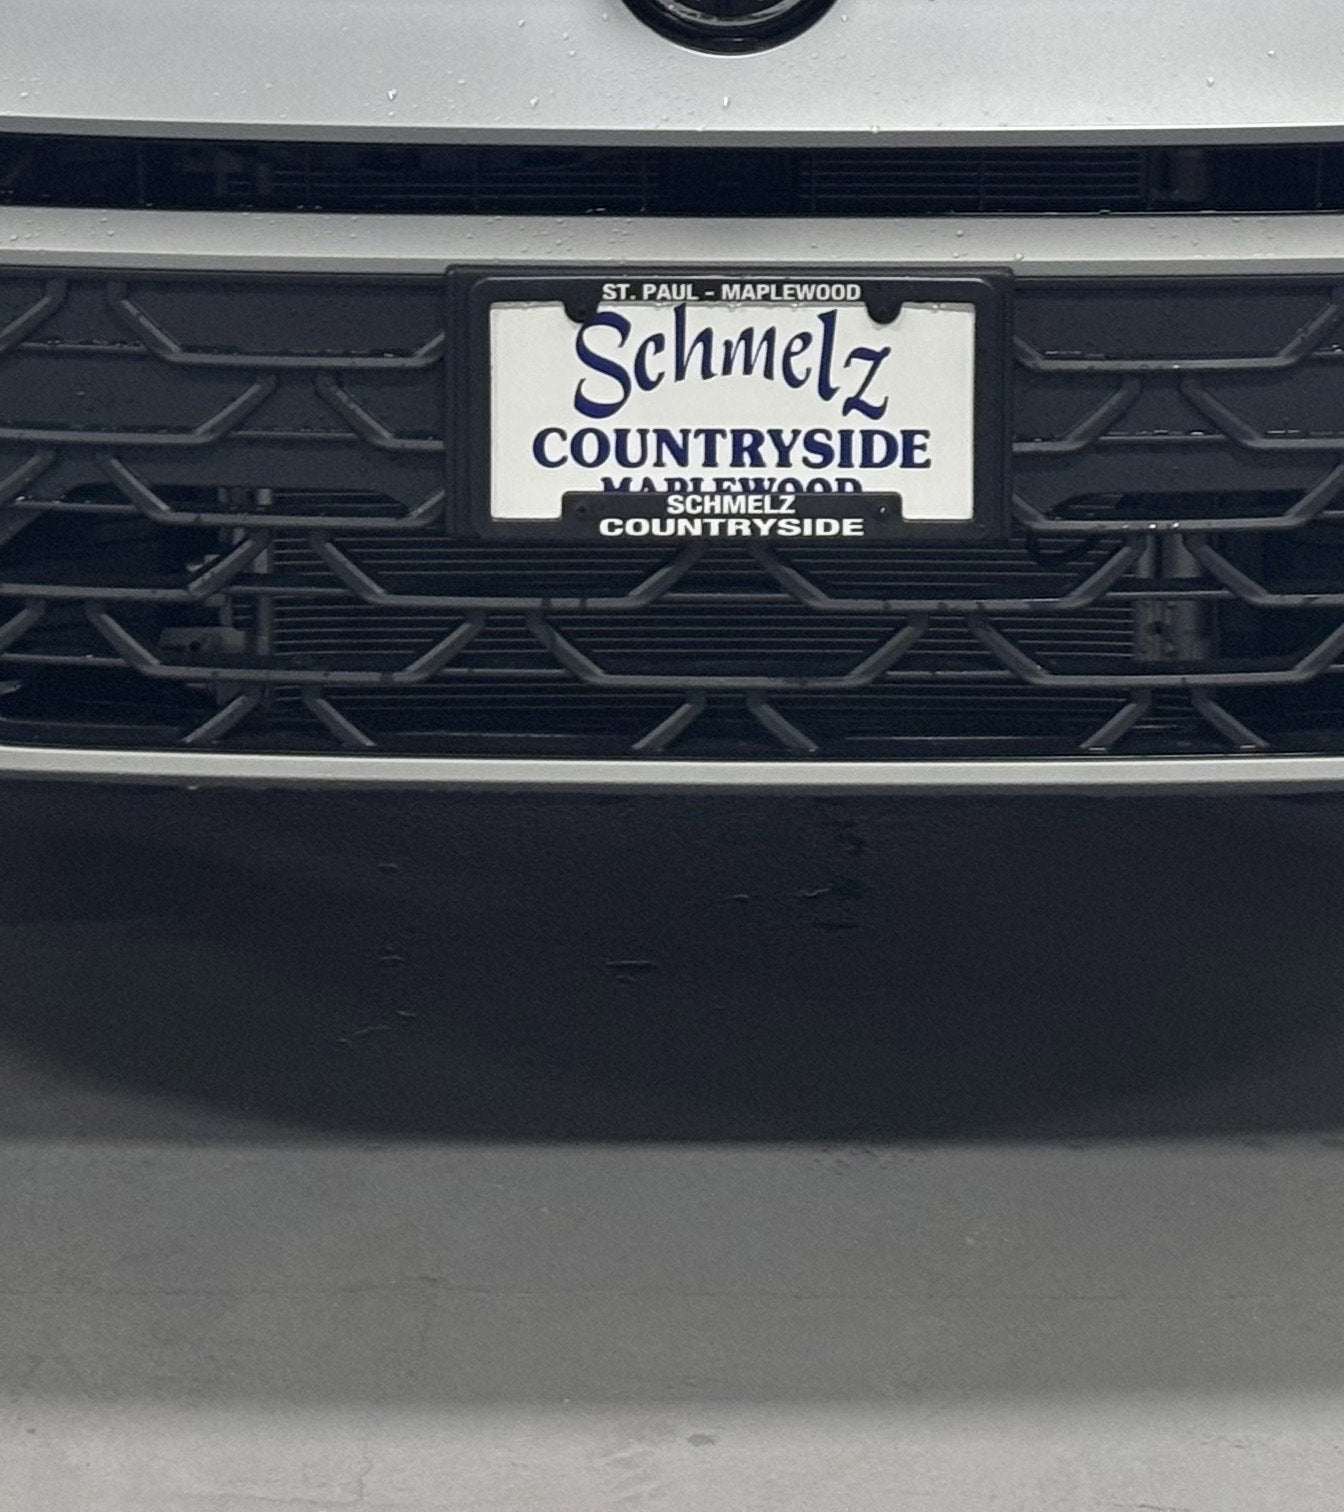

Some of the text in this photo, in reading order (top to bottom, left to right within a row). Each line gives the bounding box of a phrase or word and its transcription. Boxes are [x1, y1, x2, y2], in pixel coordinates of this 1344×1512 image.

[601, 283, 636, 301] ST.
[642, 283, 700, 301] PAUL
[721, 283, 862, 301] MAPLEWOOD
[573, 302, 892, 420] Schmelz
[531, 427, 932, 469] COUNTRYSIDE
[666, 494, 797, 515] SCHMELZ
[598, 518, 865, 537] COUNTRYSIDE
